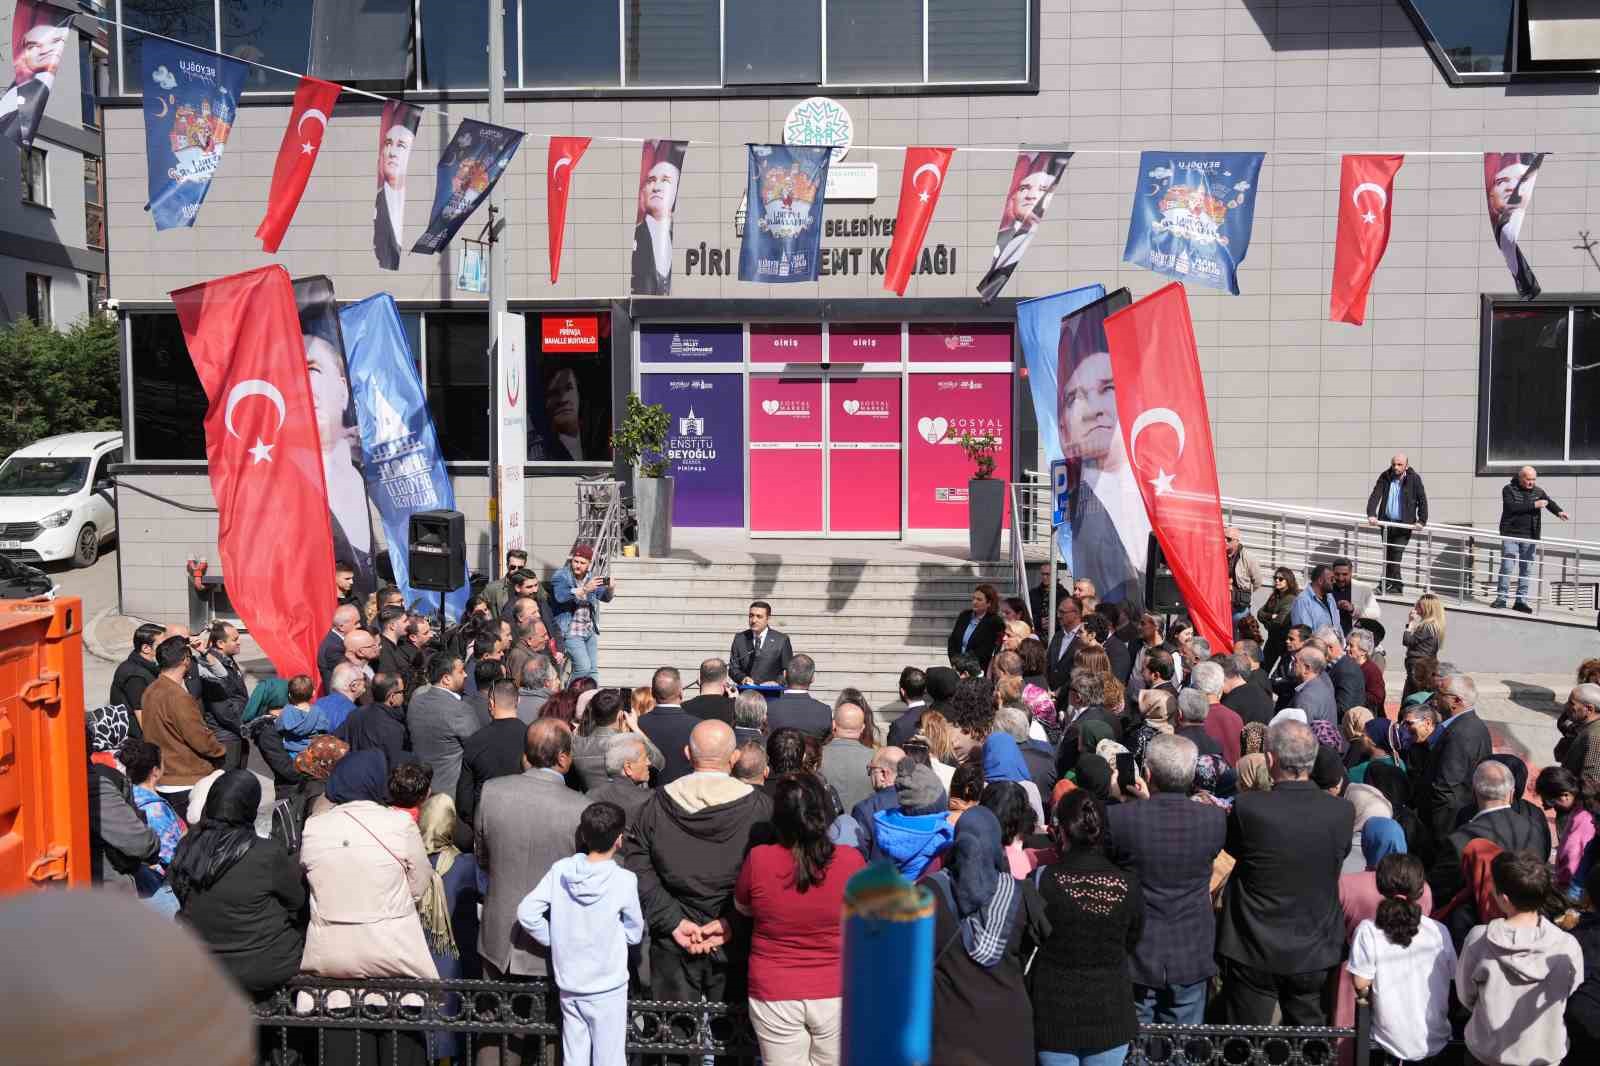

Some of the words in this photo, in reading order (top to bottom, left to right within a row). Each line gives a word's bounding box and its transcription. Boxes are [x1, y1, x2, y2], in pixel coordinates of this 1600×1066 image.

[818, 247, 863, 276] EMT
[870, 243, 956, 276] KAĞI
[950, 418, 1003, 427] SOSYAL
[671, 439, 713, 449] ENSTİTÜ
